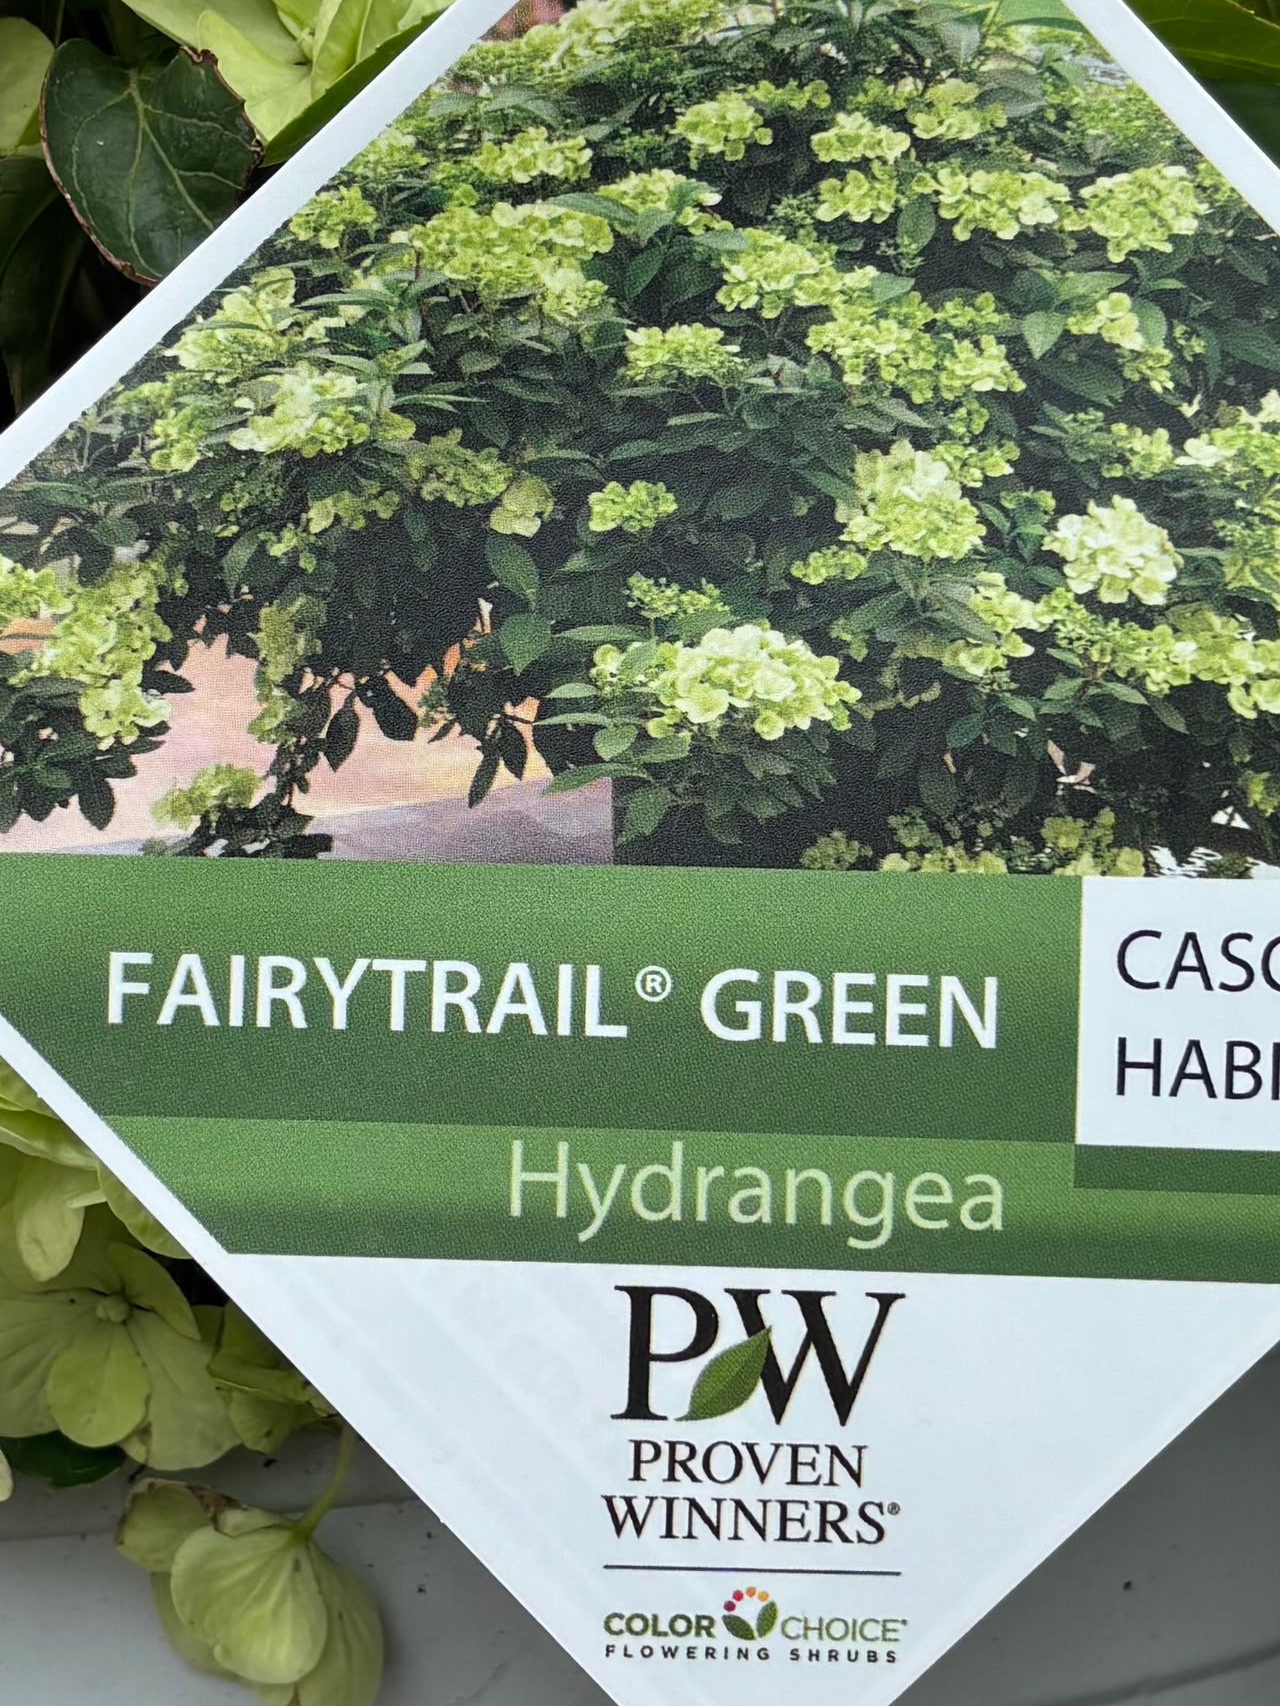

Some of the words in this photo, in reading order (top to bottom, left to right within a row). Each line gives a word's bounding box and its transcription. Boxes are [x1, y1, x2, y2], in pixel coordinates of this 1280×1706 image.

[700, 969, 1001, 1051] GREEN
[508, 1139, 1007, 1250] Hydrangea
[627, 1438, 869, 1489] PROVEN
[600, 1493, 901, 1545] WINNERS®
[602, 1611, 717, 1640] COLOR
[604, 1644, 771, 1662] FLOWERING
[789, 1647, 898, 1664] SHRUBS
